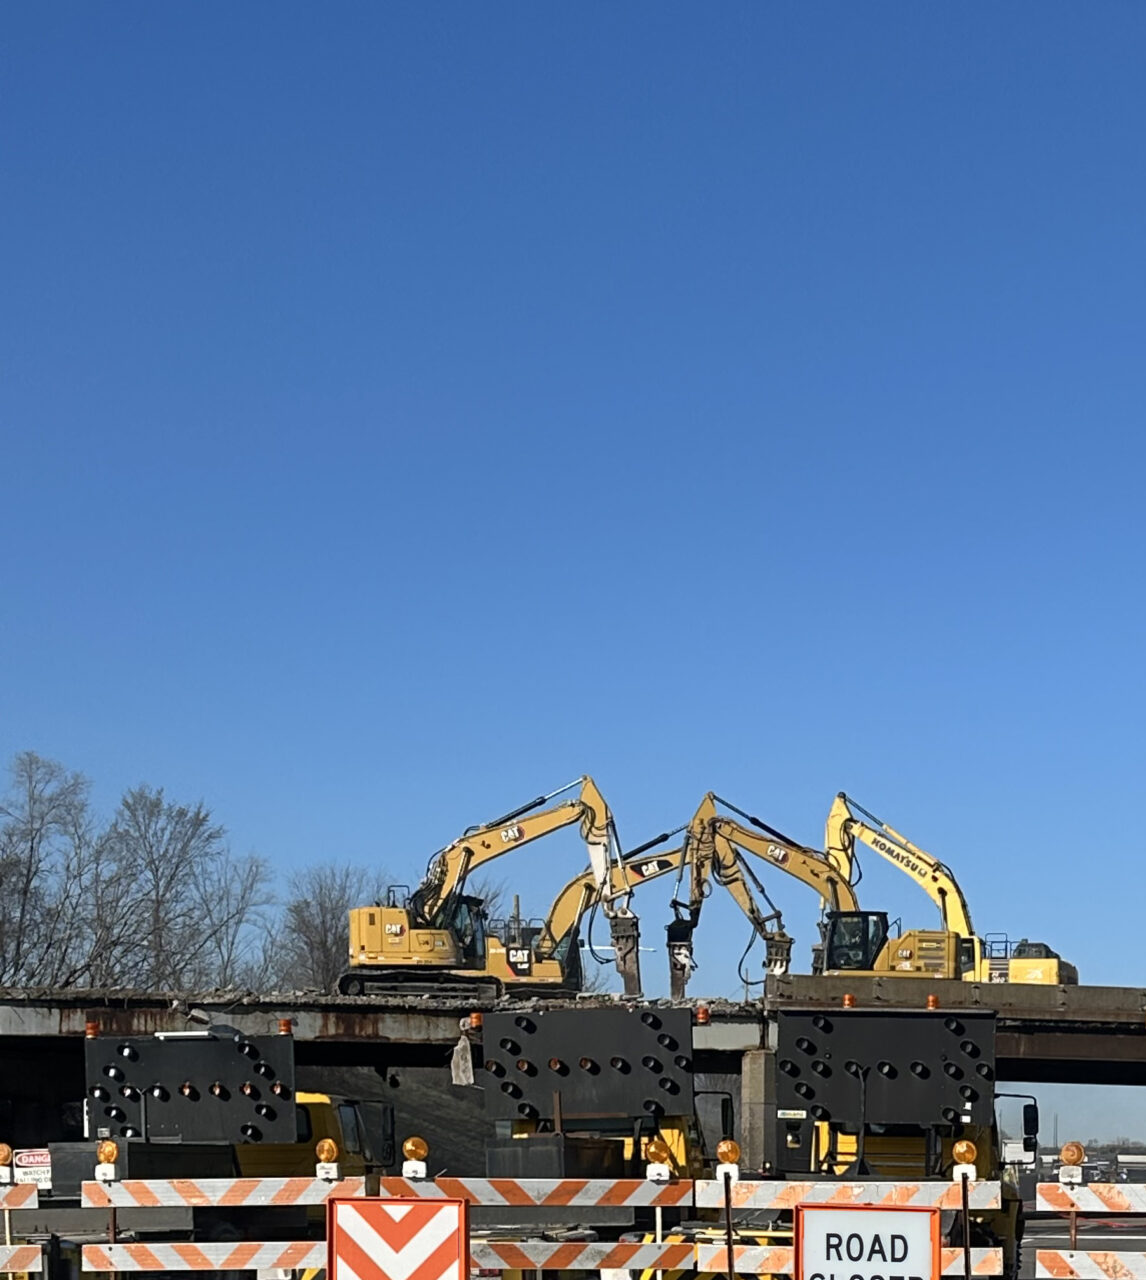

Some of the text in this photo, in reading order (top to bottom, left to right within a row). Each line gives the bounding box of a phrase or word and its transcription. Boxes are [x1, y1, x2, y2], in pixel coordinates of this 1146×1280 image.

[500, 825, 520, 843] CAT
[767, 844, 786, 860] CAT
[871, 837, 919, 872] KOMATSU
[641, 860, 660, 877] CAT
[385, 923, 402, 934] CAT
[509, 949, 529, 962] CAT
[898, 949, 911, 958] CAT
[825, 1233, 909, 1262] ROAD
